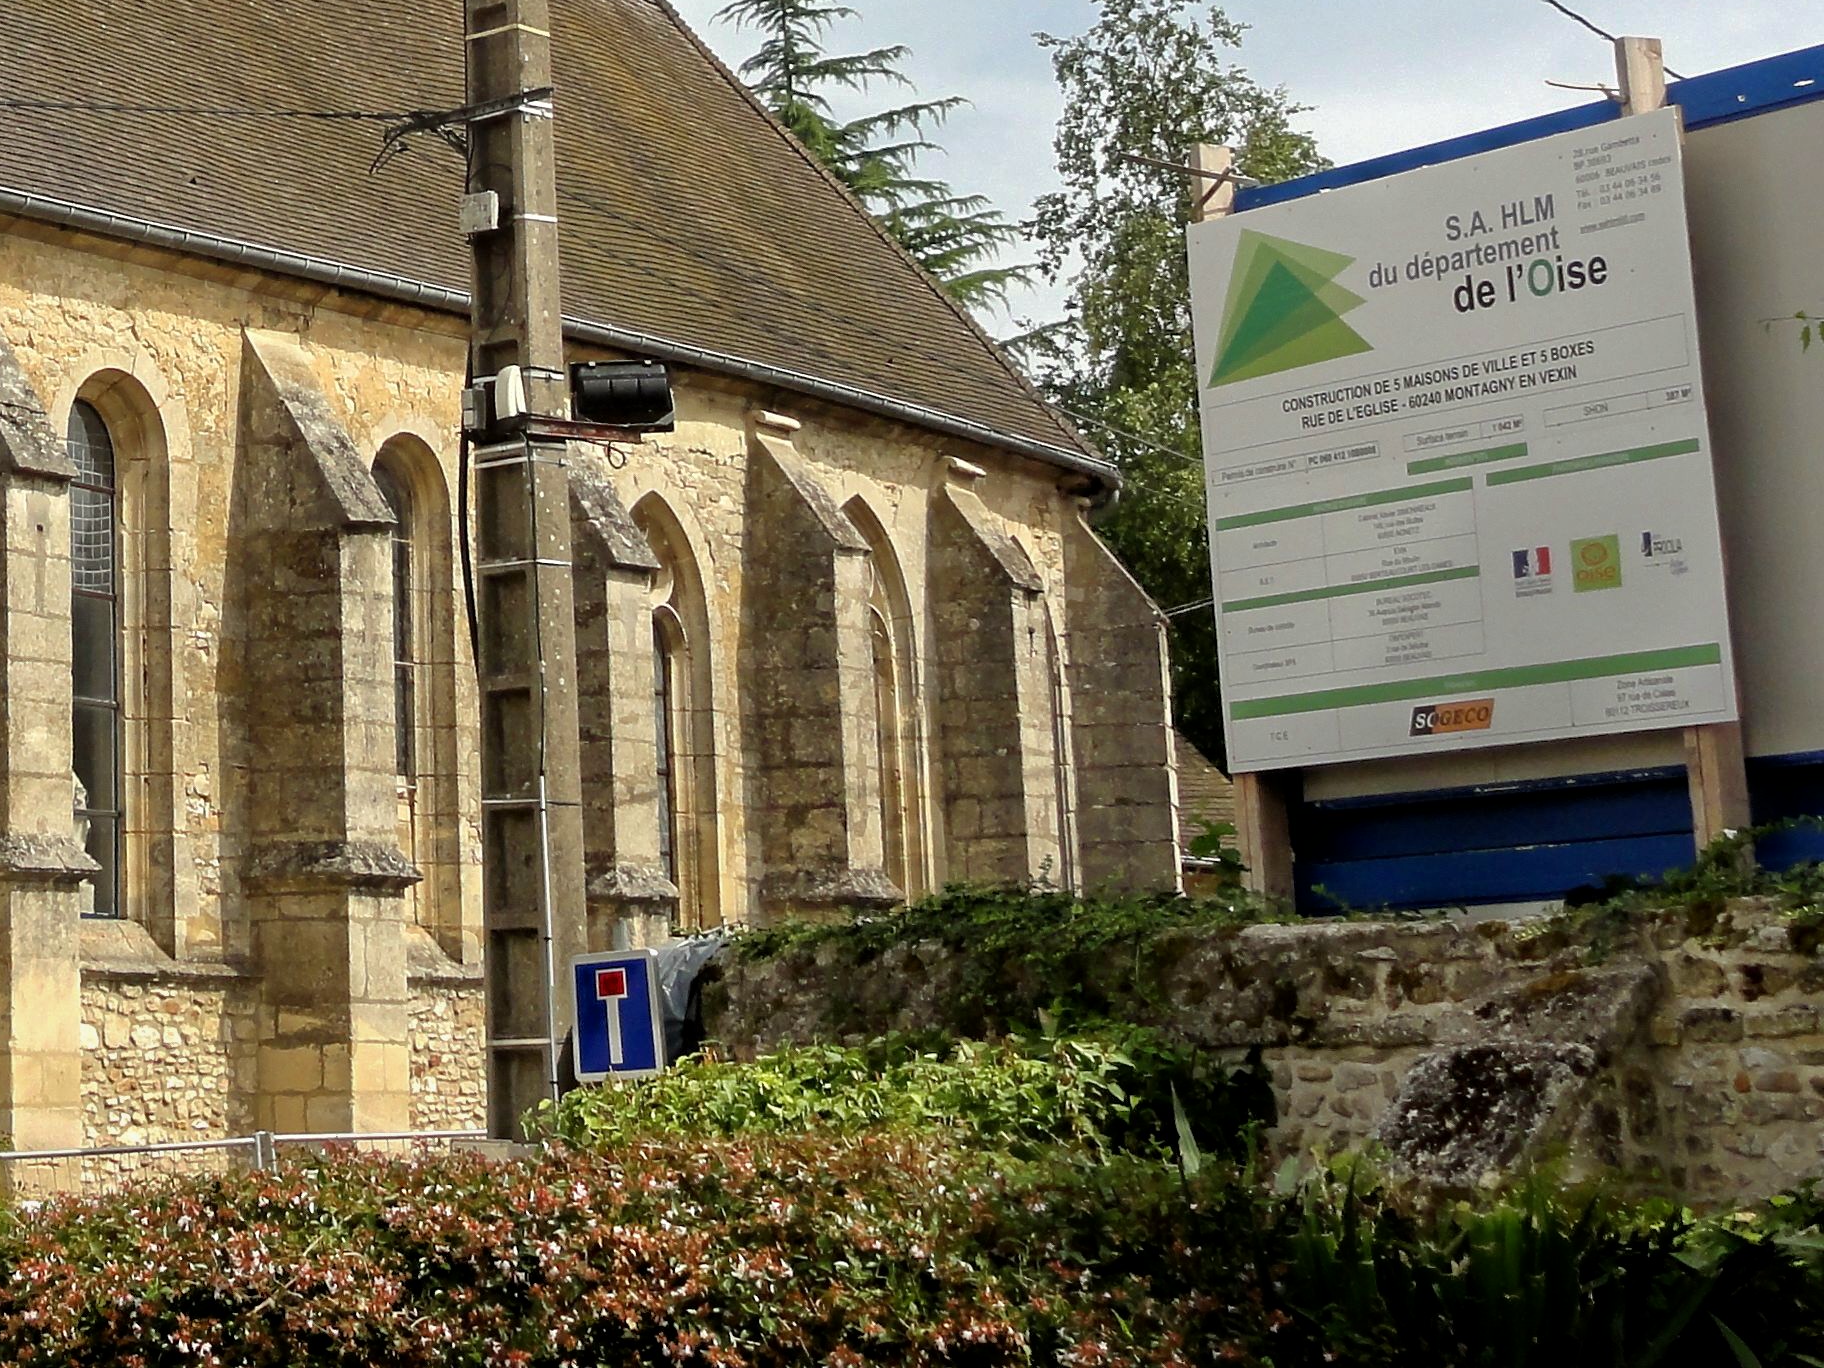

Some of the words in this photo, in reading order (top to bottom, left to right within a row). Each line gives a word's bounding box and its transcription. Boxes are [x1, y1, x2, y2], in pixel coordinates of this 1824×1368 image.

[1605, 160, 1646, 177] BEAUVAIS
[1446, 210, 1493, 241] S.A.
[1501, 194, 1554, 229] HLM
[1369, 263, 1398, 288] du
[1406, 225, 1560, 281] département
[1454, 274, 1496, 313] de
[1506, 255, 1607, 302] l'Oise
[1282, 383, 1371, 412] CONSTRUCTION
[1374, 380, 1391, 395] DE
[1394, 378, 1401, 391] 5
[1403, 367, 1459, 389] MAISONS
[1463, 363, 1479, 378] DE
[1482, 356, 1518, 374] VILLE
[1521, 351, 1537, 367] ET
[1540, 350, 1548, 363] 5
[1550, 341, 1594, 361] BOXES
[1302, 412, 1325, 429] RUE
[1328, 409, 1344, 424] DE
[1347, 399, 1399, 421] L'EGLISE
[1409, 391, 1442, 409] 60240
[1445, 377, 1515, 402] MONTAGNY
[1519, 373, 1536, 388] EN
[1539, 365, 1577, 384] VEXIN
[1308, 456, 1319, 466] PC
[1415, 706, 1489, 729] SOGECO
